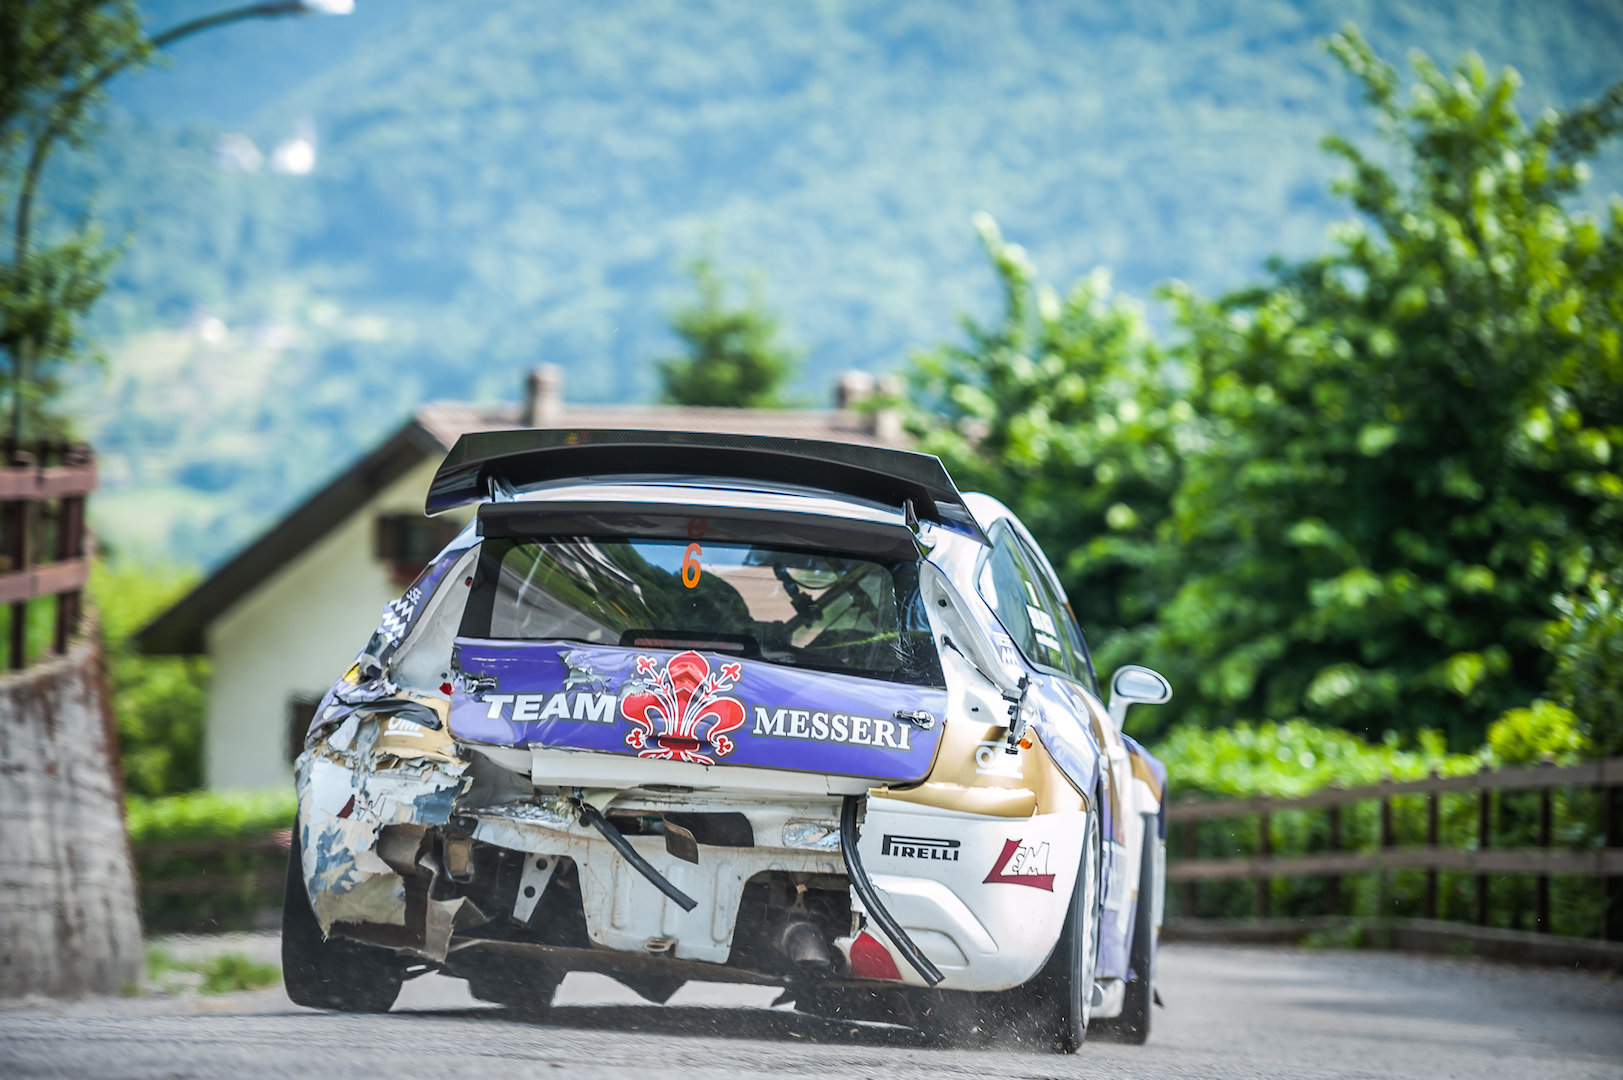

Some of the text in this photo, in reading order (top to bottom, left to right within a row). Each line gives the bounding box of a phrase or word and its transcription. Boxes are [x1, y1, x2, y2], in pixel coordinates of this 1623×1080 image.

[682, 542, 703, 589] 6
[481, 692, 913, 750] TEAM MESSERI
[881, 834, 961, 861] PIRELLI
